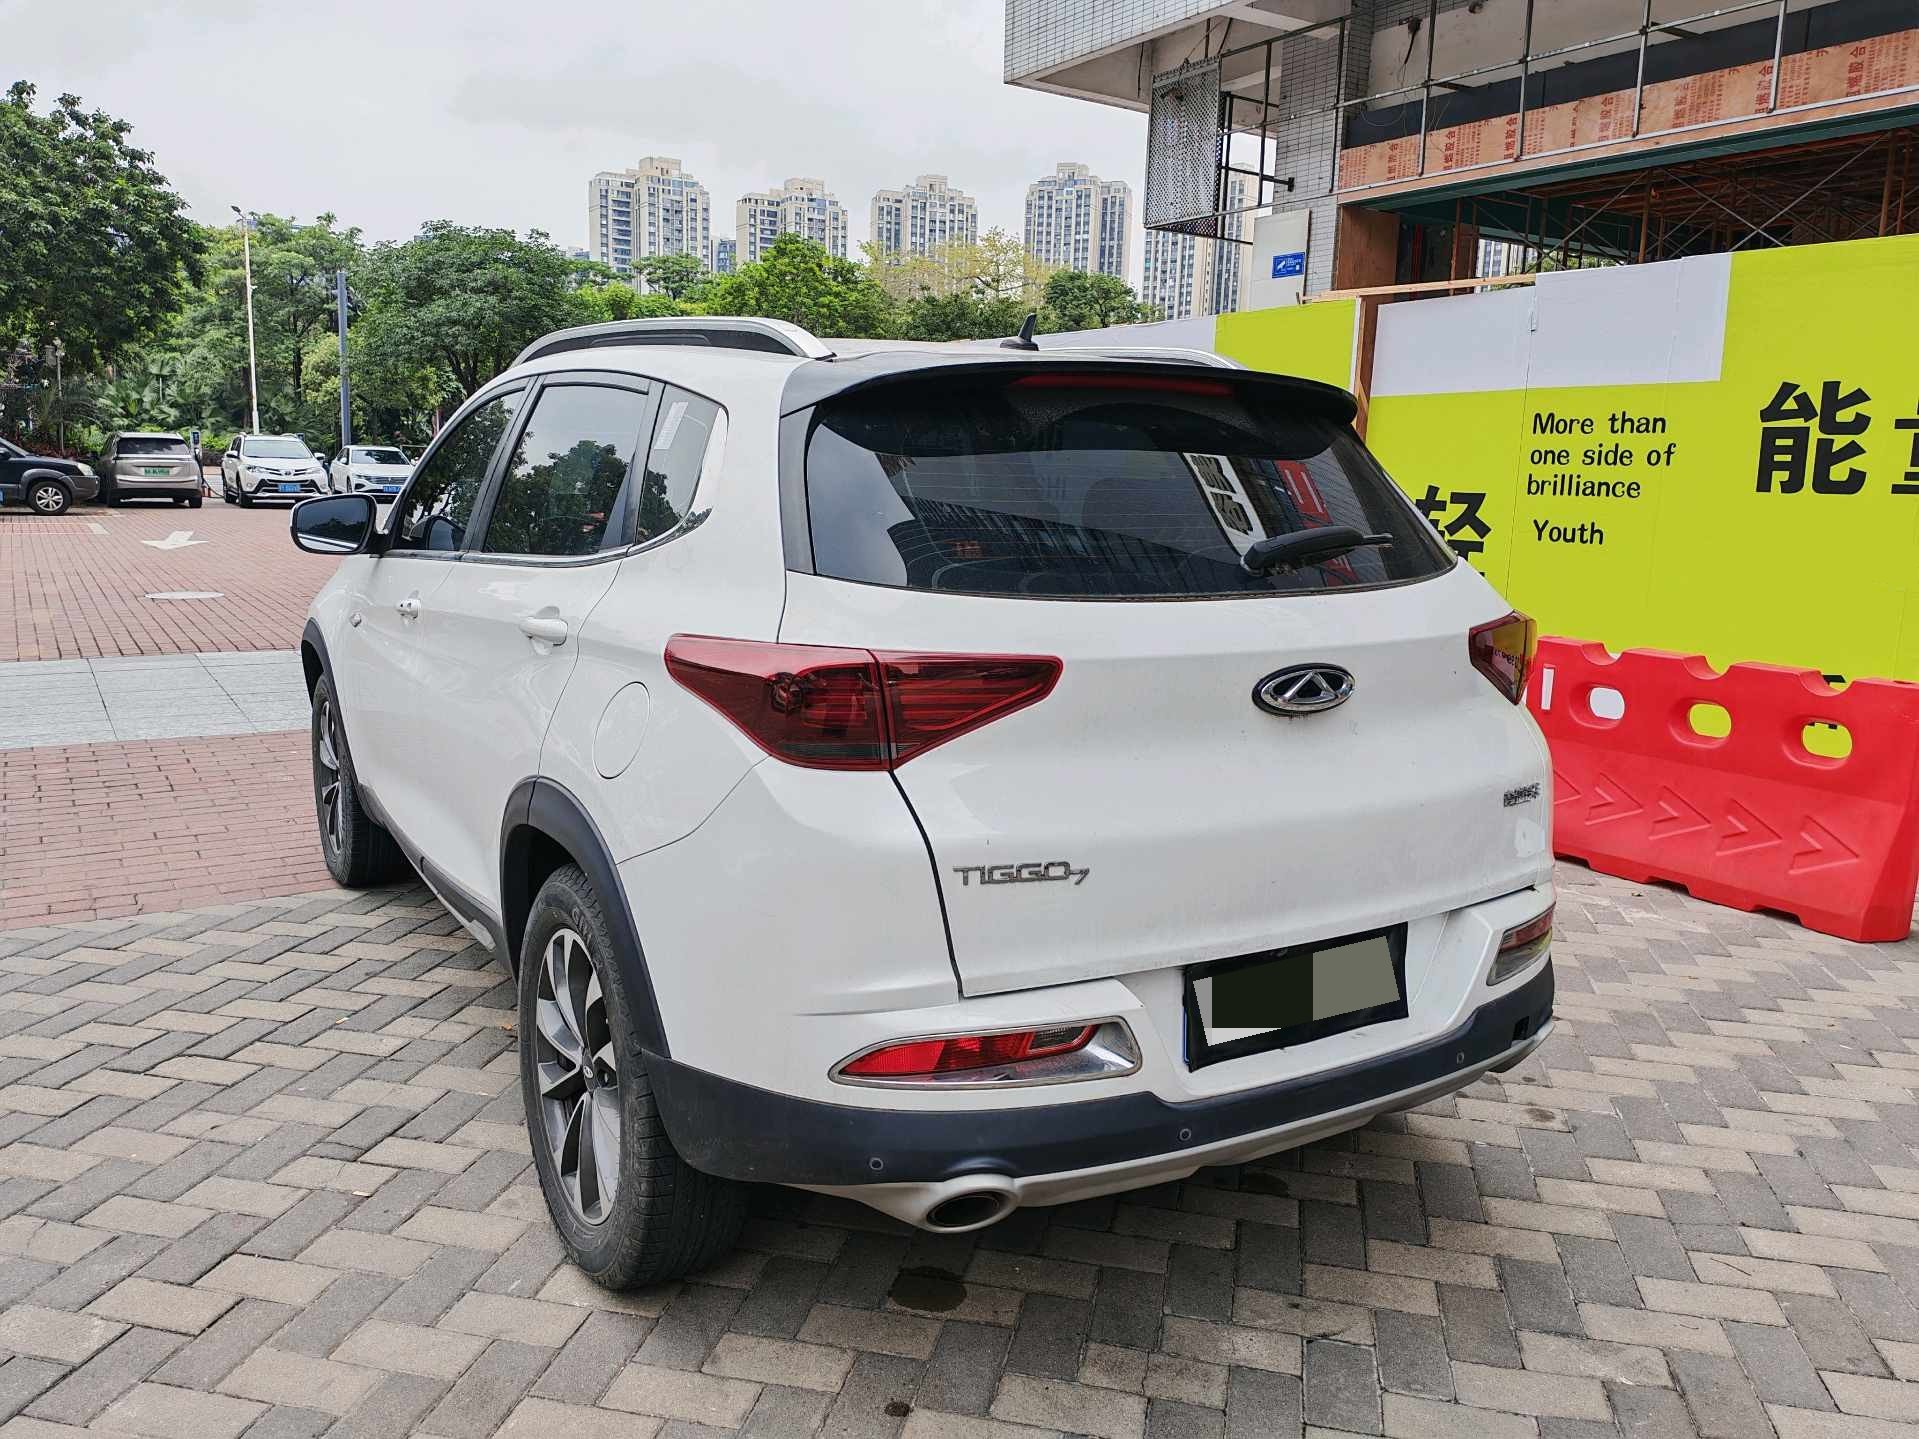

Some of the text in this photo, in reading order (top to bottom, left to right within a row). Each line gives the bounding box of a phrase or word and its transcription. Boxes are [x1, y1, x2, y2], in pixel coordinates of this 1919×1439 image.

[1533, 411, 1666, 434] More than
[1756, 380, 1919, 494] 能
[1530, 443, 1676, 466] one side of
[1527, 473, 1641, 498] brilliance
[1533, 519, 1604, 545] Youth
